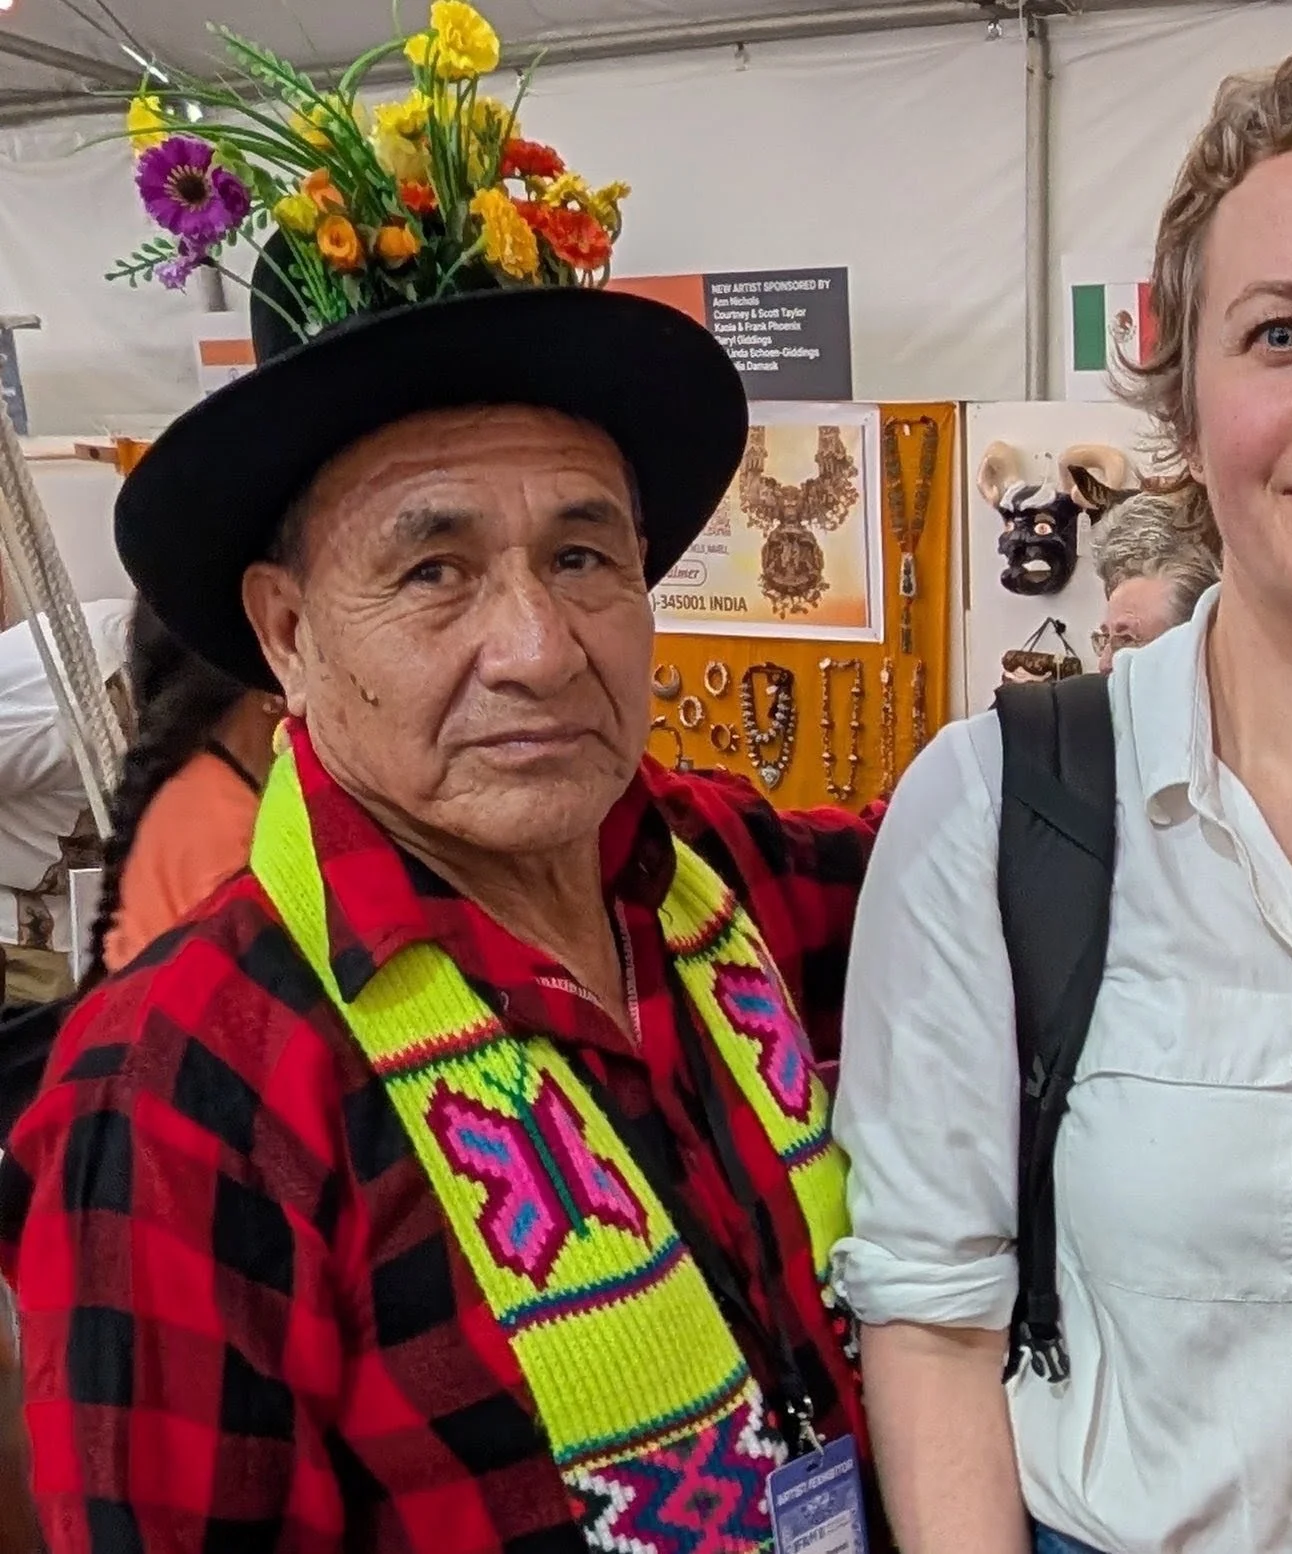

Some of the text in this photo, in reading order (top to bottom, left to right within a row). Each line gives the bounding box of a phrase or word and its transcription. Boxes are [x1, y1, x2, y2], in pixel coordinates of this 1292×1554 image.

[712, 279, 831, 294] NEW ARTIST SPONSORED BY
[730, 296, 760, 306] Nichols
[713, 308, 807, 320] Courtney & Scott Taylor
[745, 322, 767, 331] Frank
[768, 321, 801, 331] Phoenix
[737, 335, 772, 346] Giddings
[709, 596, 748, 612] INDIA
